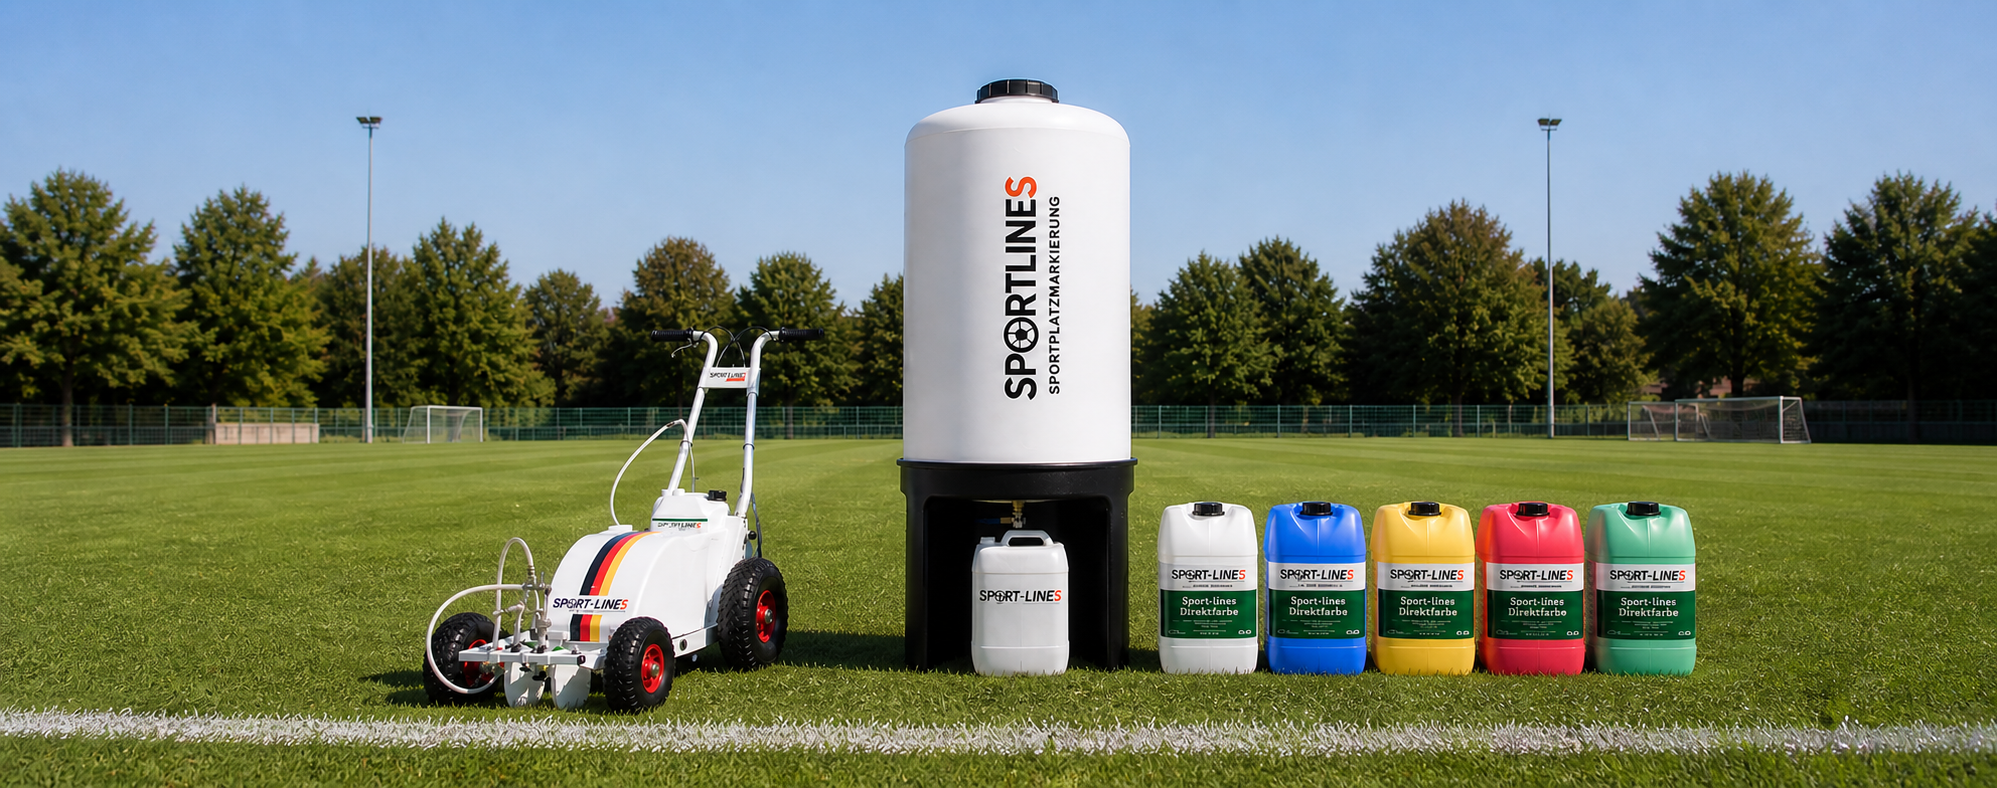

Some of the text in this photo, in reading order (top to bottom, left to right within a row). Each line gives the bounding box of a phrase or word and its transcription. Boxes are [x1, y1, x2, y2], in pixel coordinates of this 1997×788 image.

[1003, 176, 1039, 401] SPORTLINES
[1049, 196, 1060, 395] SPORTPLATZMARKIERUNG
[1171, 569, 1246, 580] SPORT-LINES
[1280, 569, 1354, 580] SPORT-LINES
[1390, 569, 1464, 580] SPORT-LINES
[1499, 569, 1573, 580] SPORT-LINES
[1609, 570, 1686, 580] SPORT-LINES
[979, 590, 1062, 602] SPORT-LINES
[1182, 596, 1237, 607] Sport-lines
[1290, 596, 1346, 607] Sport-lines
[1400, 596, 1455, 606] Sport-lines
[1620, 597, 1677, 606] Sport-lines
[552, 598, 628, 610] SPORT-LINES
[1618, 606, 1679, 617] Direktfarbe
